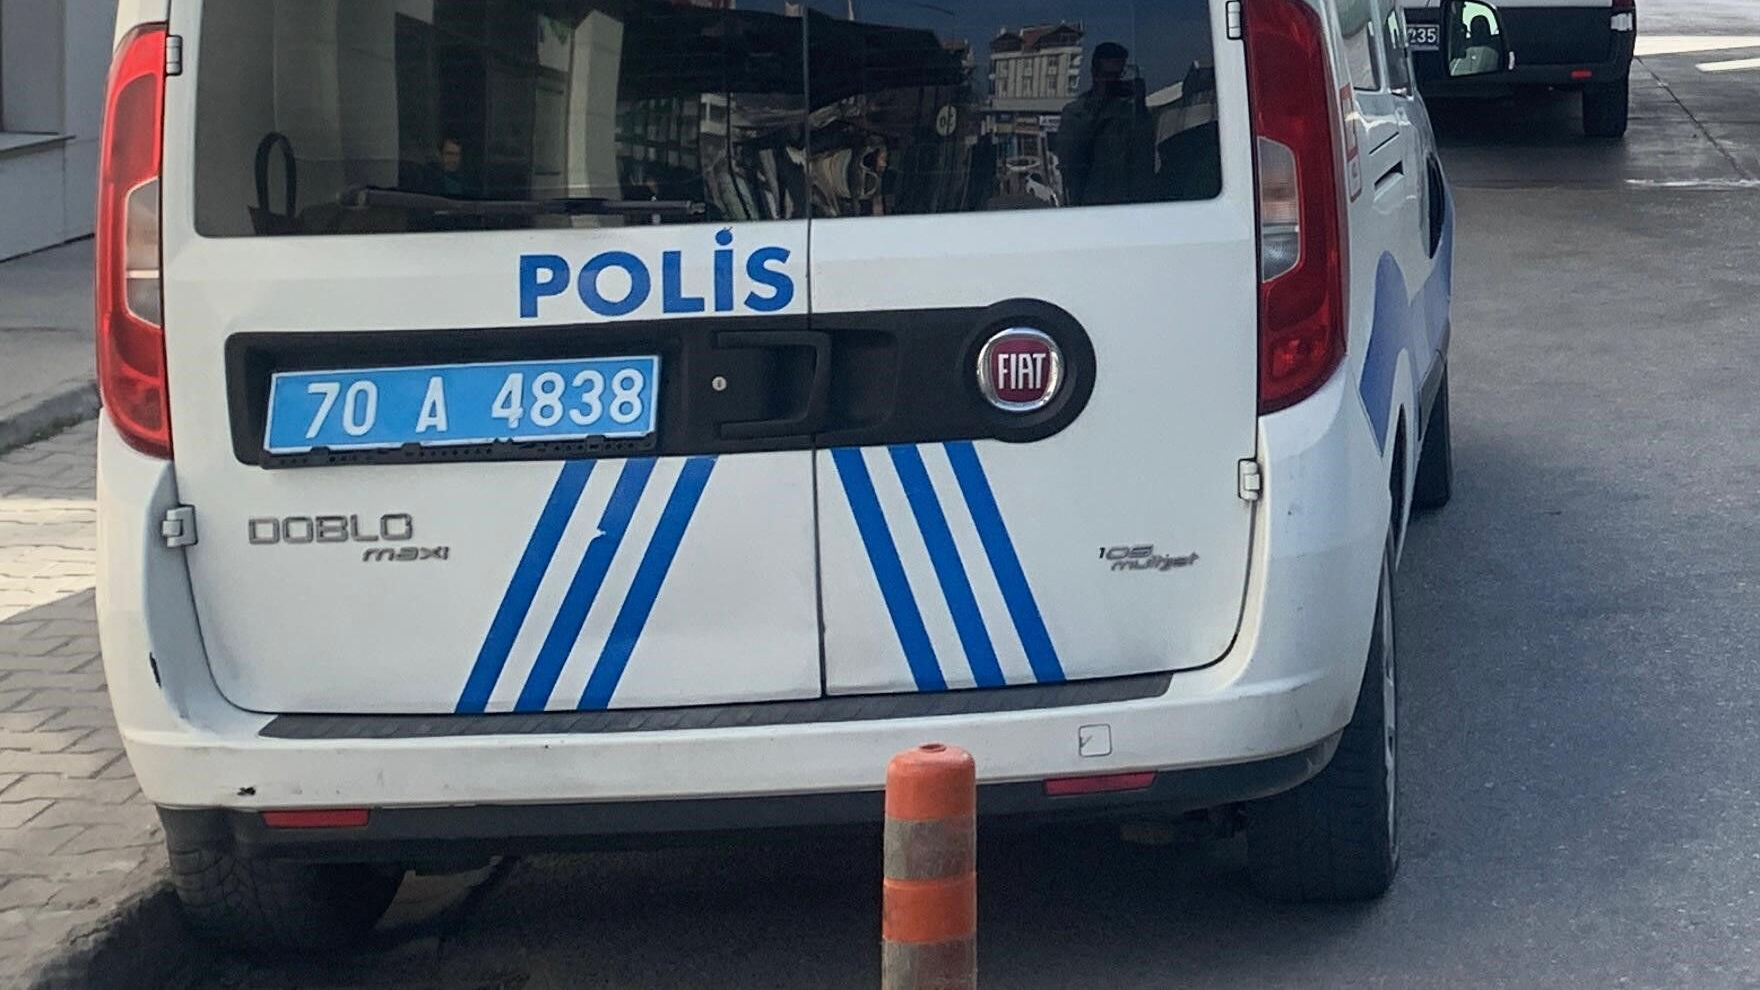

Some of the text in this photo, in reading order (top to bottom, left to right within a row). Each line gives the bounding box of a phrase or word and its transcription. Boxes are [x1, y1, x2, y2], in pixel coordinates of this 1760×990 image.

[519, 226, 795, 319] POLİS
[998, 352, 1046, 390] FIAT
[304, 368, 645, 440] 70 A 4838
[248, 513, 414, 545] DOBLO
[362, 546, 450, 562] maxi
